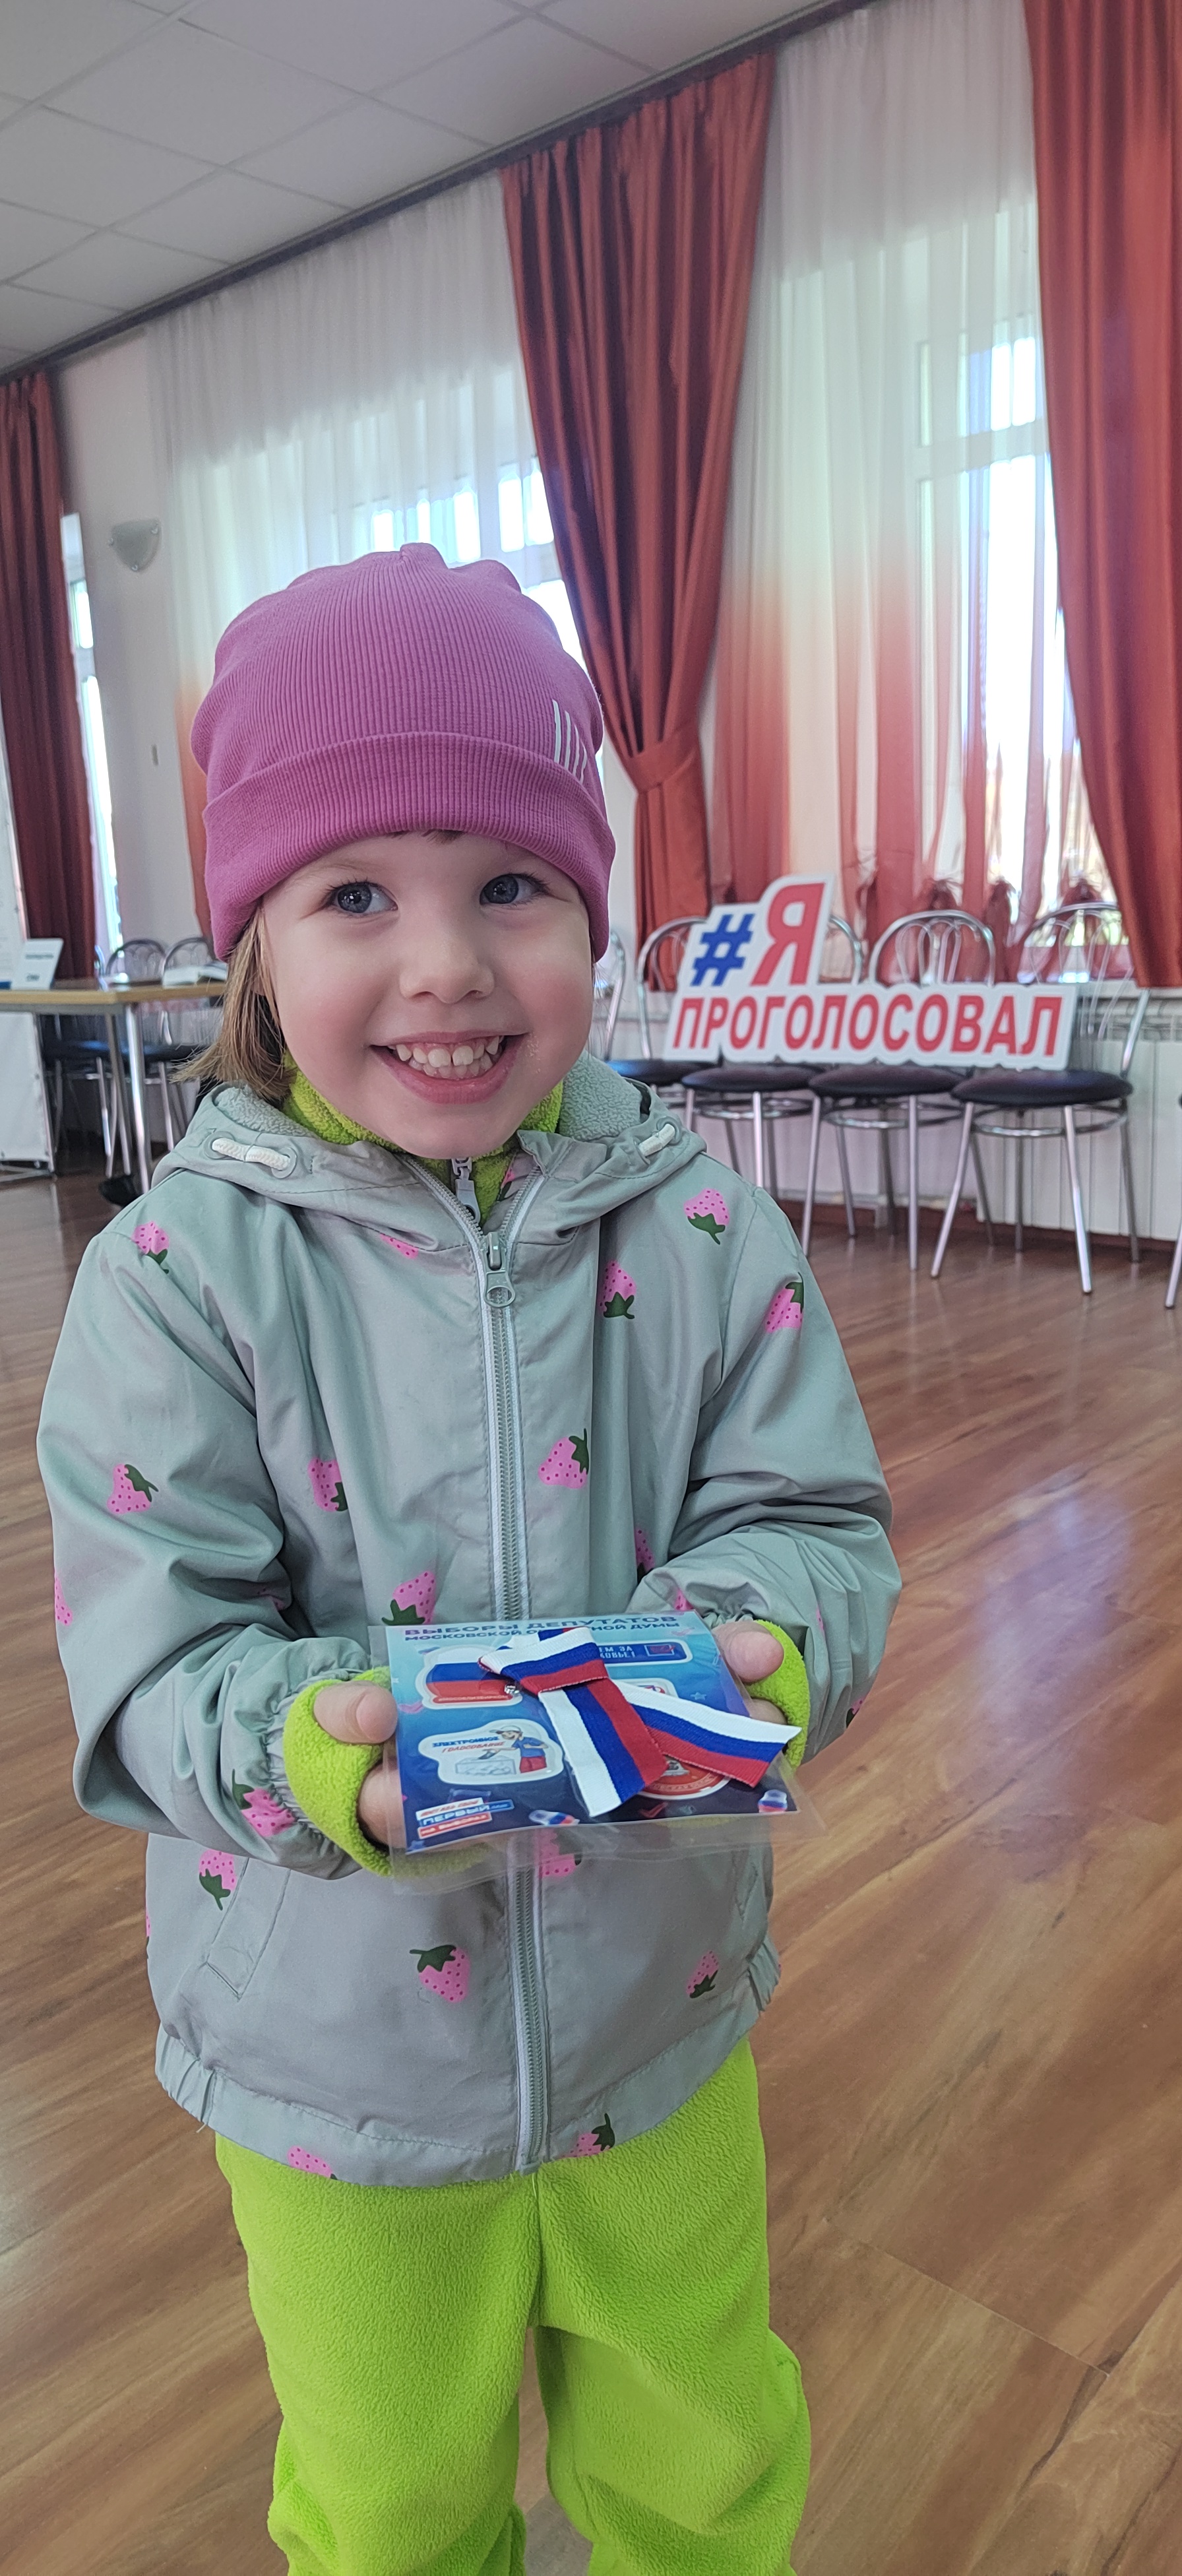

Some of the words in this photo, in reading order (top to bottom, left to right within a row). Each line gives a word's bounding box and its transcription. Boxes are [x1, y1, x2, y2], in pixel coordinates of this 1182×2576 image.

[691, 882, 825, 986] #Я
[673, 993, 1063, 1056] ПРОГОЛОСОВАЛ
[405, 1624, 518, 1635] ВЫБОРЫ
[527, 1616, 677, 1629] ДЕПУТАТОВ
[405, 1630, 522, 1640] МОСКОВСКОЙ
